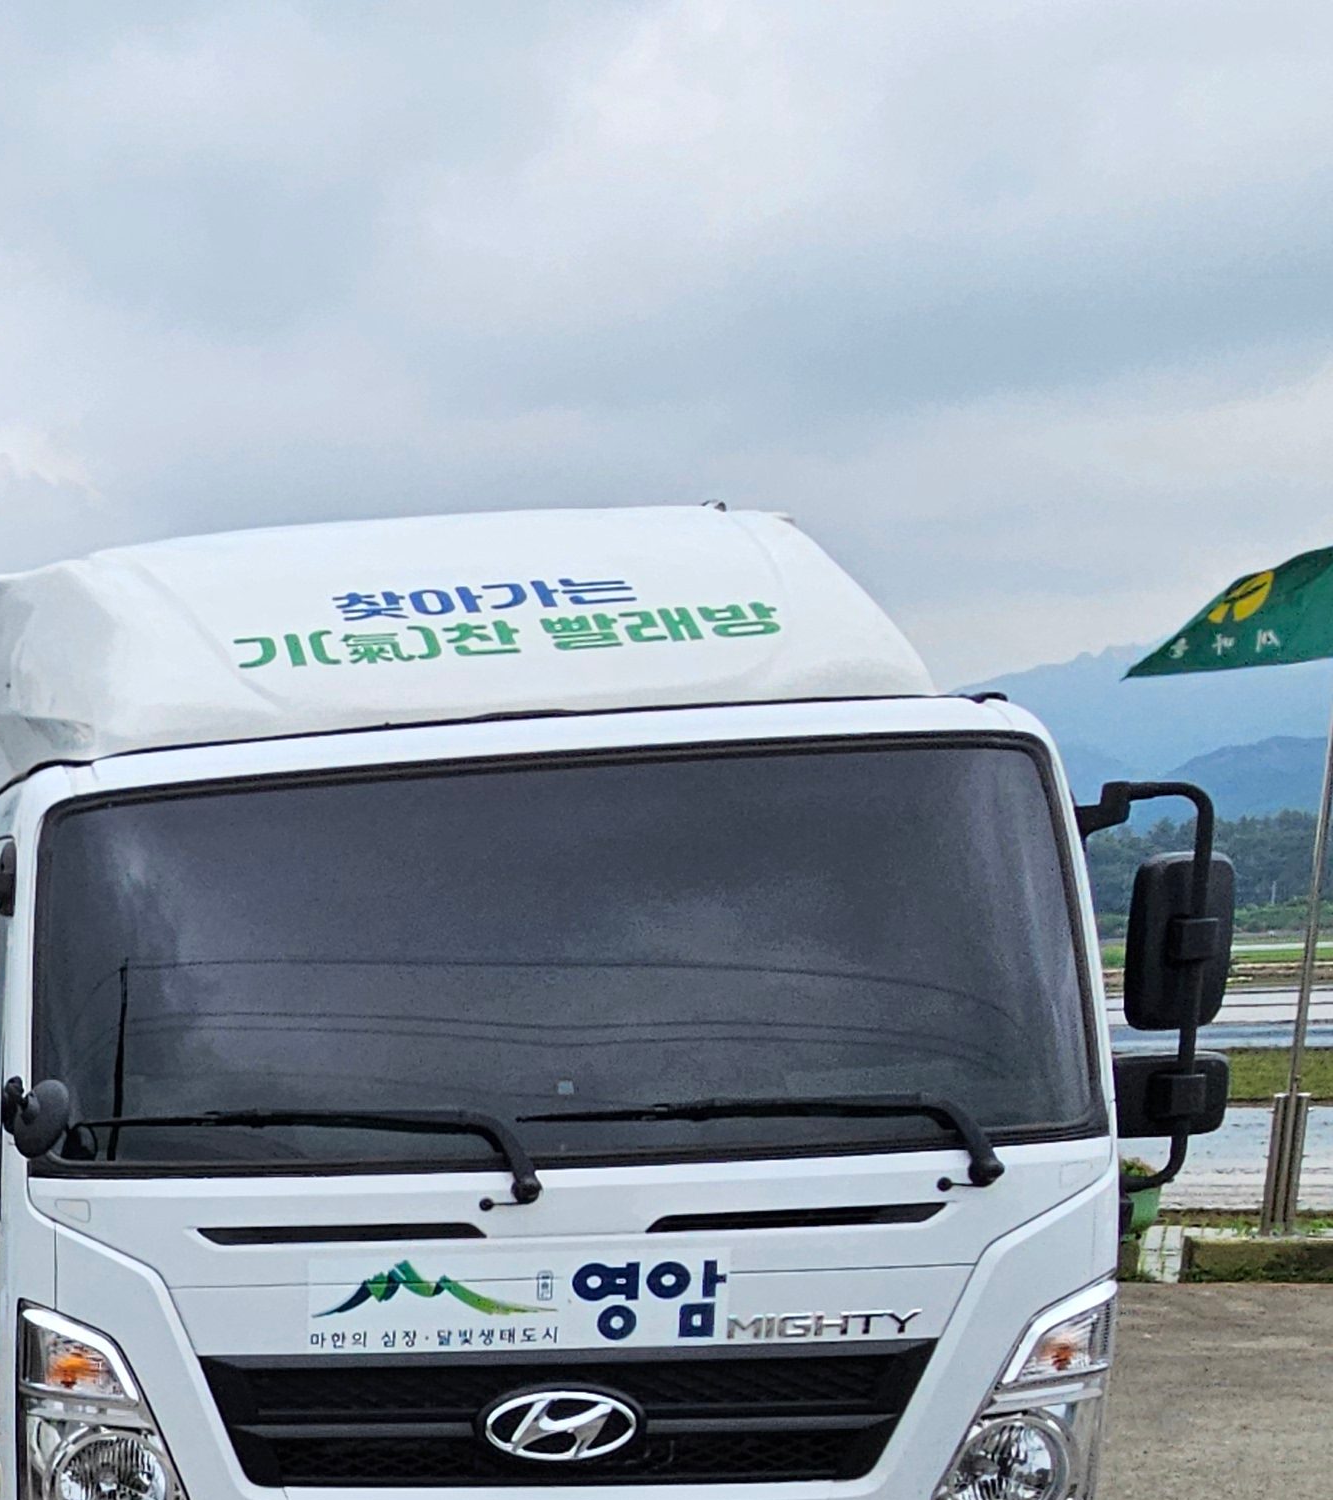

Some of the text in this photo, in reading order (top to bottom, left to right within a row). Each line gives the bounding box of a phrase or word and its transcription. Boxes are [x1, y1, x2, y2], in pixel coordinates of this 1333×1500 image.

[334, 577, 637, 622] 찾아가는
[236, 600, 781, 670] 기(氣)찬 빨래방
[571, 1260, 728, 1341] 영암
[309, 1331, 367, 1349] 마한의
[727, 1308, 923, 1339] MIGHTY
